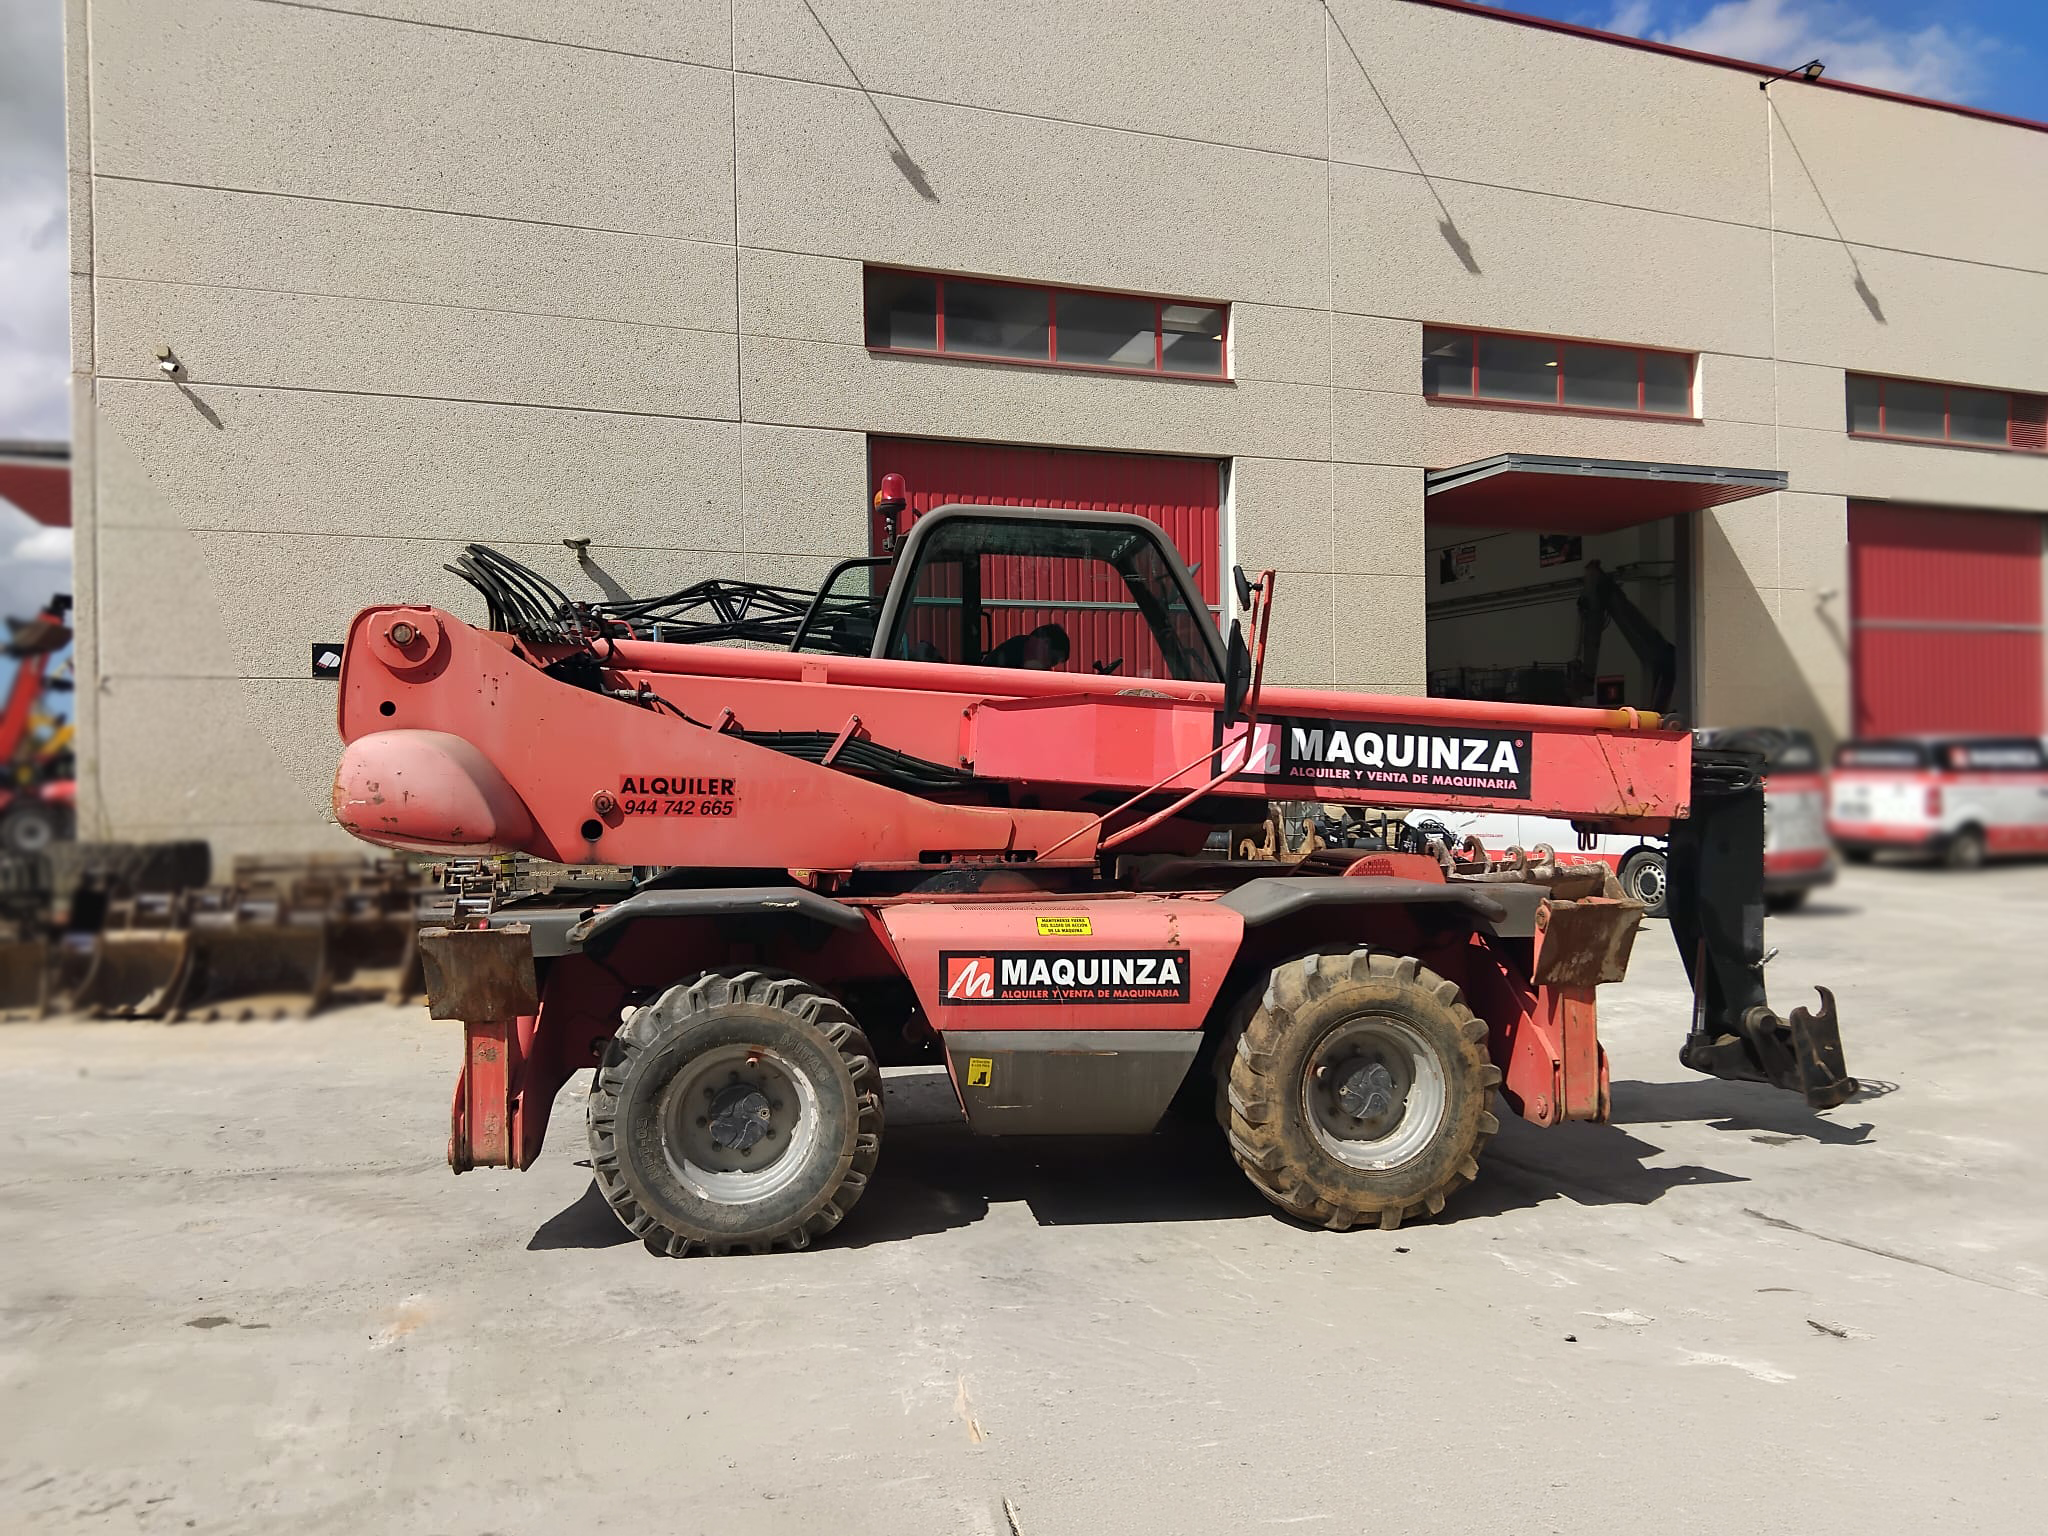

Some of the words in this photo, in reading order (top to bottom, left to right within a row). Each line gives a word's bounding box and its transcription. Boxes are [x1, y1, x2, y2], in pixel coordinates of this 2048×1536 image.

[1291, 727, 1520, 774] MAQUINZA
[620, 777, 735, 796] ALQUILER
[1290, 766, 1351, 780] ALQUILER
[1354, 770, 1363, 780] Y
[1366, 770, 1409, 784] VENTA
[1412, 773, 1429, 785] DE
[1432, 775, 1518, 790] MAQUINARIA
[624, 799, 658, 816] 944
[664, 800, 696, 816] 742
[700, 800, 734, 816] 665
[1001, 958, 1181, 988] MAQUINZA
[1001, 989, 1049, 999] ALQUILER
[1052, 989, 1060, 998] Y
[1062, 989, 1095, 998] VENTA
[1097, 989, 1110, 998] DE
[1113, 989, 1180, 998] MAQUINARIA
